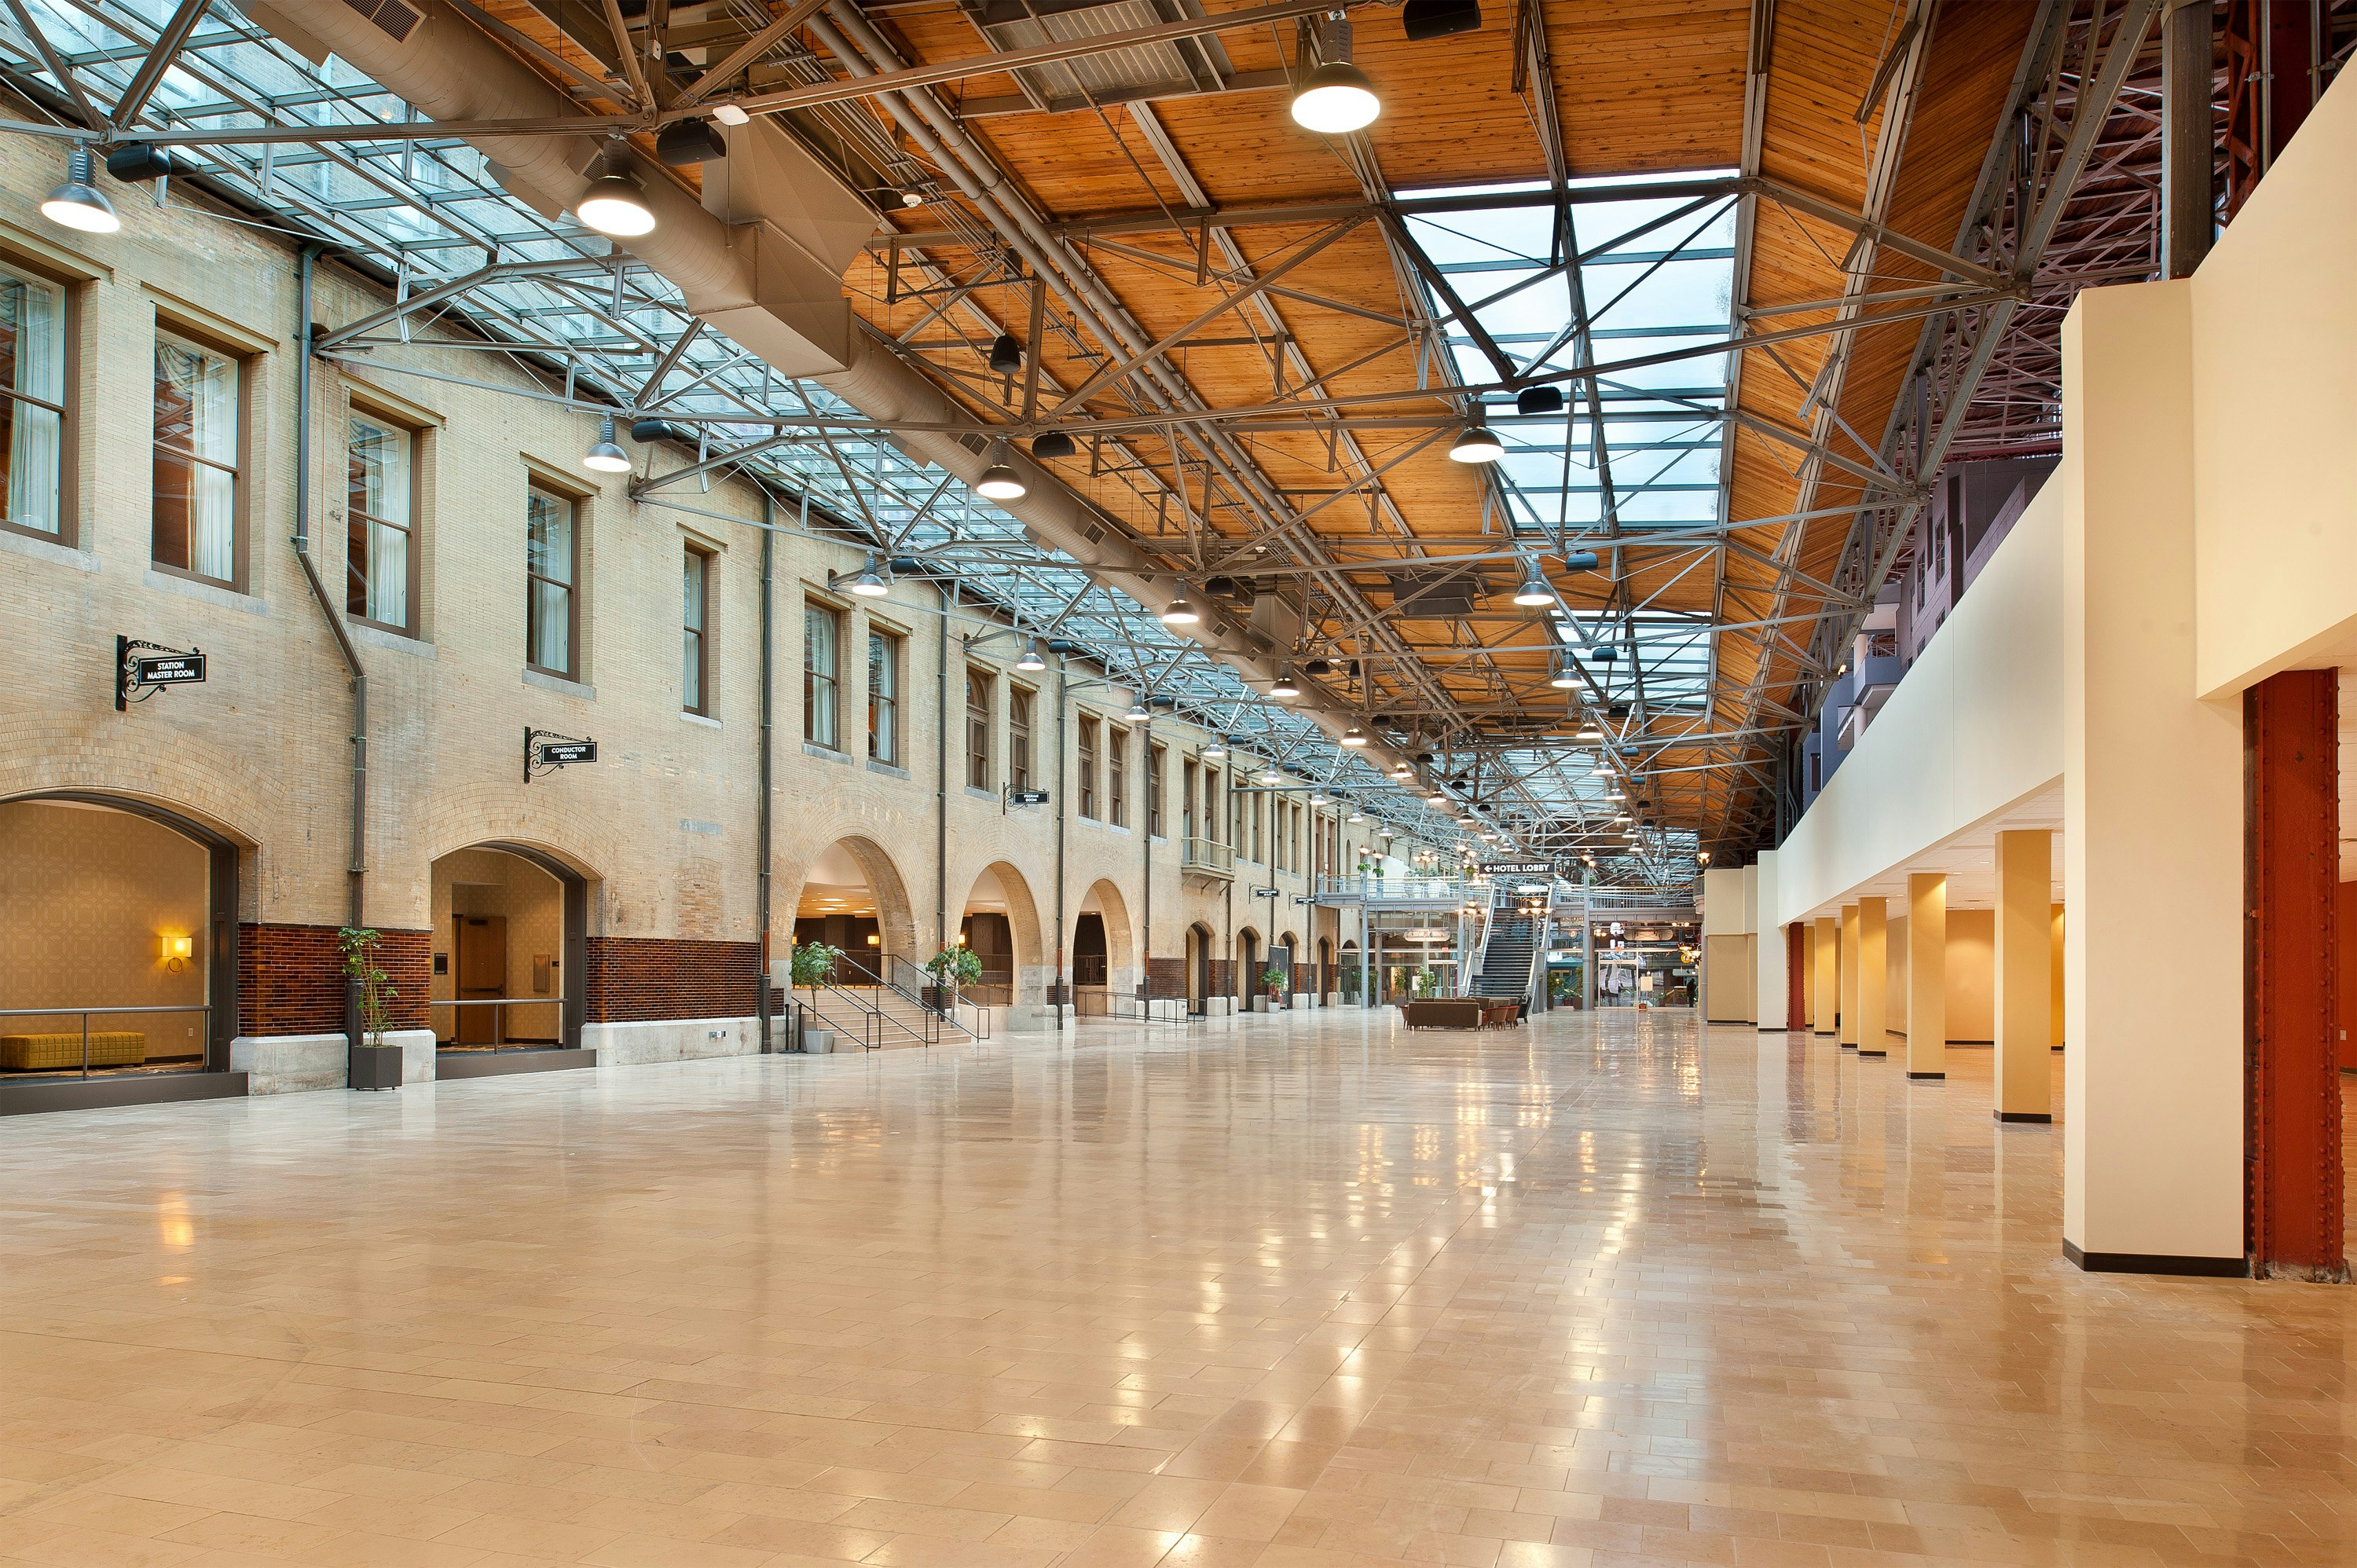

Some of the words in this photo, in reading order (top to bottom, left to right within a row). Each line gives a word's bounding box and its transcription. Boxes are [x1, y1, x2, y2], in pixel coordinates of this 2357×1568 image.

[157, 661, 185, 670] STATION
[147, 671, 173, 680] MASTER
[174, 669, 196, 678] ROOM
[1493, 864, 1521, 873] HOTEL
[1523, 863, 1550, 872] LOBBY
